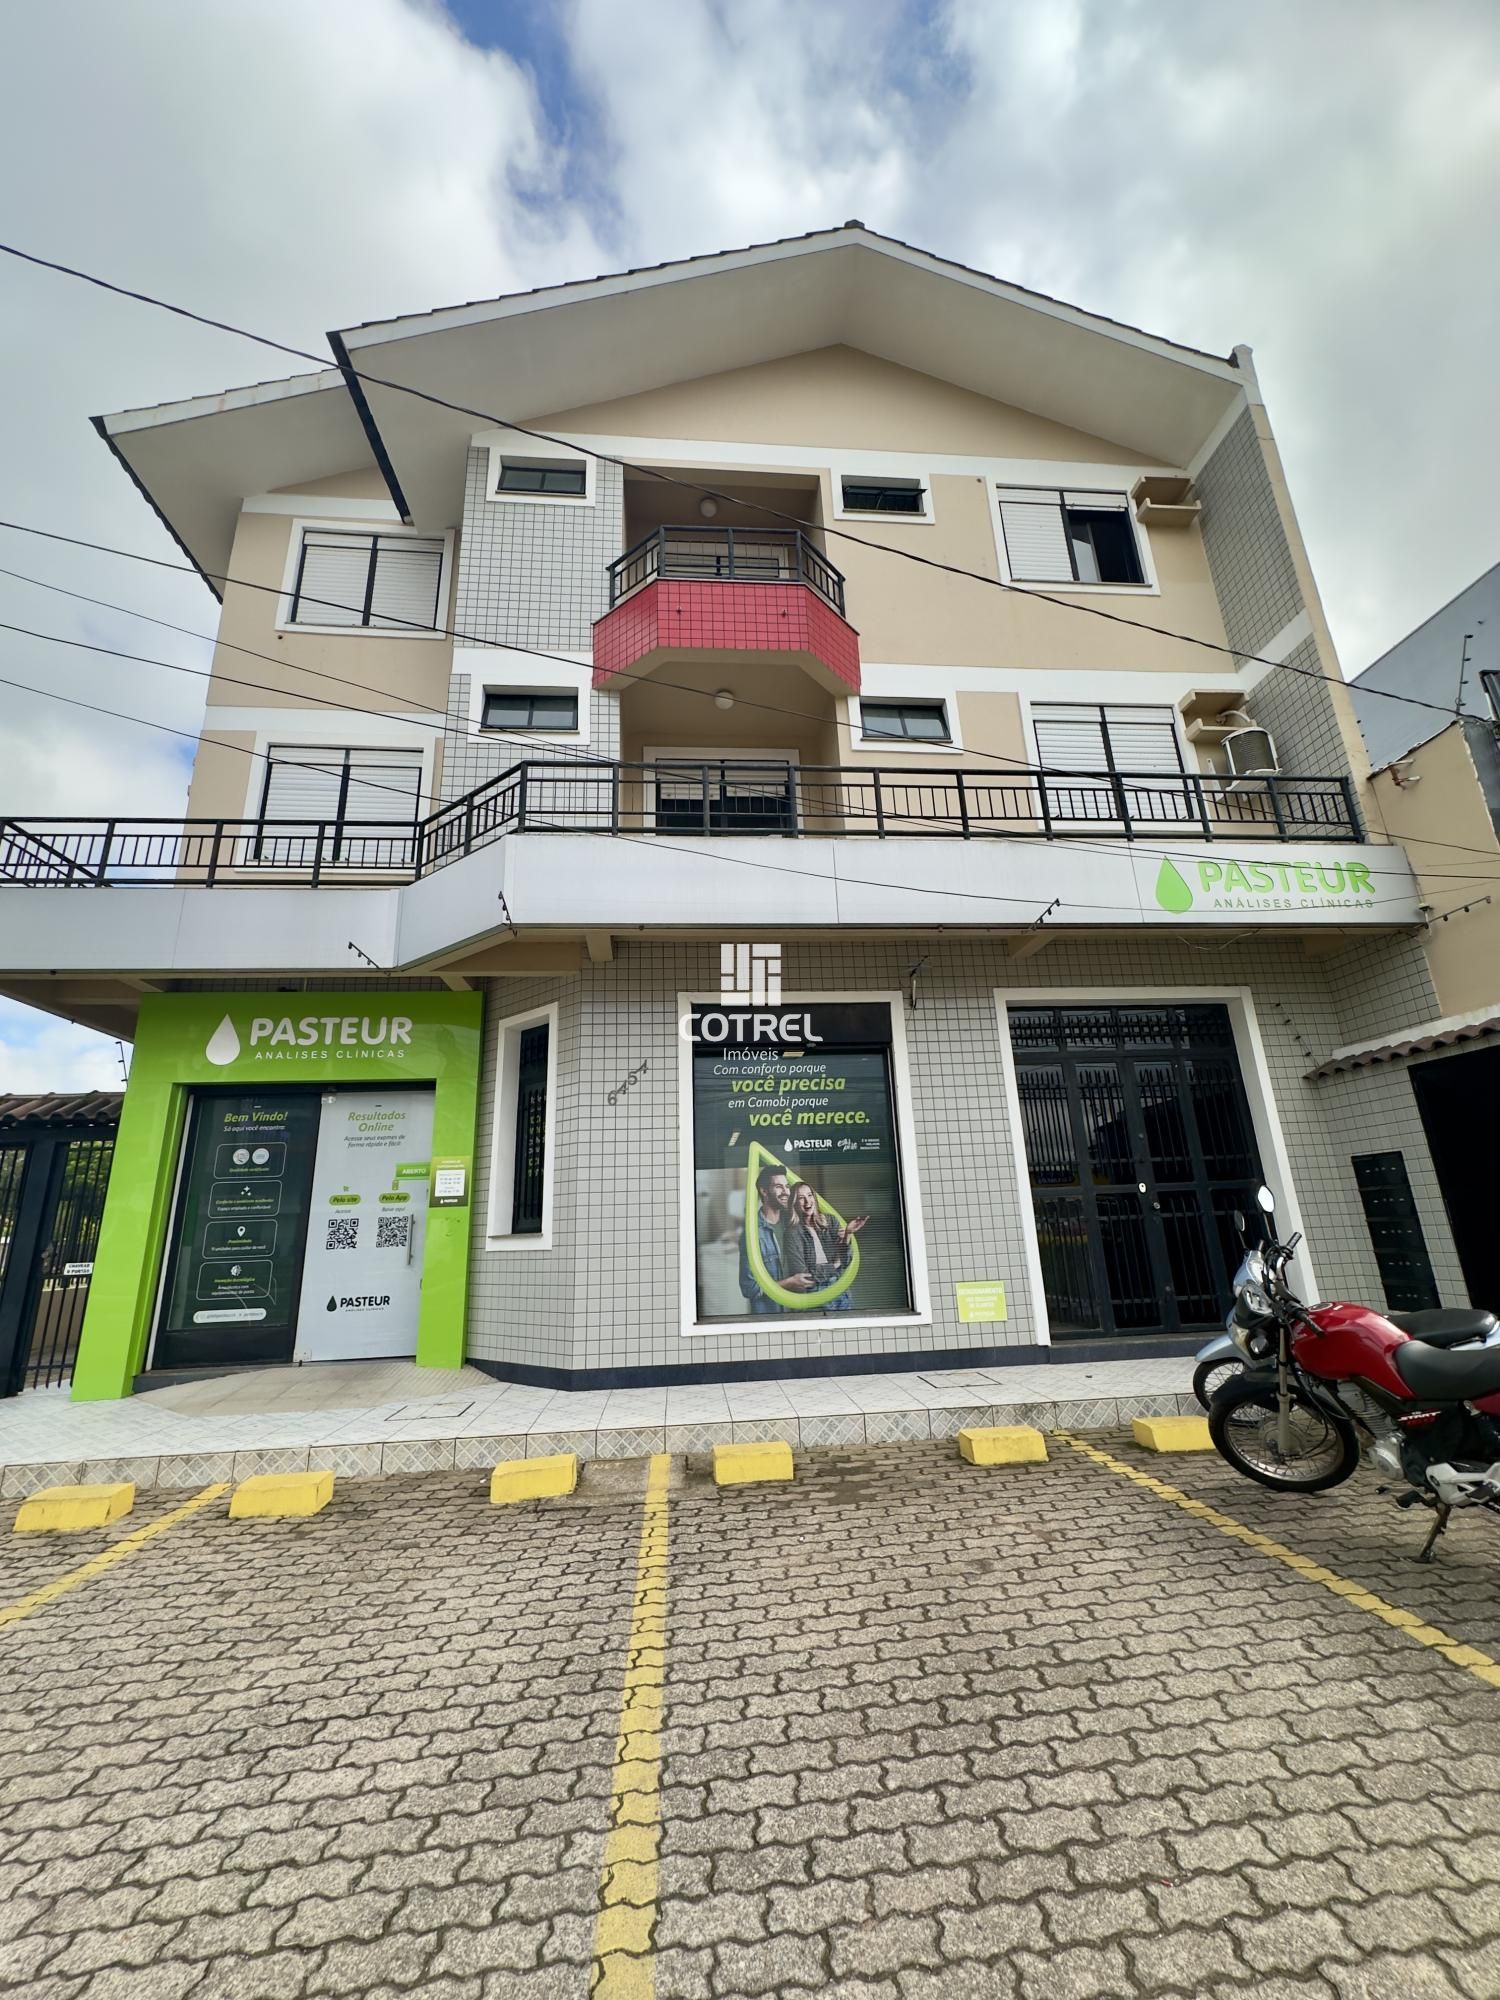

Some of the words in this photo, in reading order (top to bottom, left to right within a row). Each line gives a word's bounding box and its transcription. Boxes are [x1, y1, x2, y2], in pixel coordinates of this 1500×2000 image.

[1197, 860, 1376, 895] PASTEUR
[1213, 896, 1292, 909] ANÁLISES
[1300, 897, 1374, 909] CLÍNICAS
[250, 1016, 414, 1046] PASTEUR
[335, 1048, 405, 1059] CLÍNICAS
[713, 1064, 739, 1075] Com
[741, 1062, 787, 1076] conforto
[789, 1063, 827, 1076] porque
[731, 1075, 775, 1093] você
[778, 1073, 846, 1095] precisa
[728, 1100, 745, 1108] em
[747, 1096, 790, 1108] Camobi
[791, 1097, 829, 1110] porque
[224, 1113, 249, 1122] Bem
[252, 1111, 288, 1121] Vindo!
[348, 1111, 406, 1121] Resultados
[749, 1109, 792, 1127] você
[796, 1111, 870, 1125] merece.
[358, 1122, 394, 1132] Online
[794, 1139, 833, 1148] PASTEUR
[340, 1295, 390, 1308] PASTEUR
